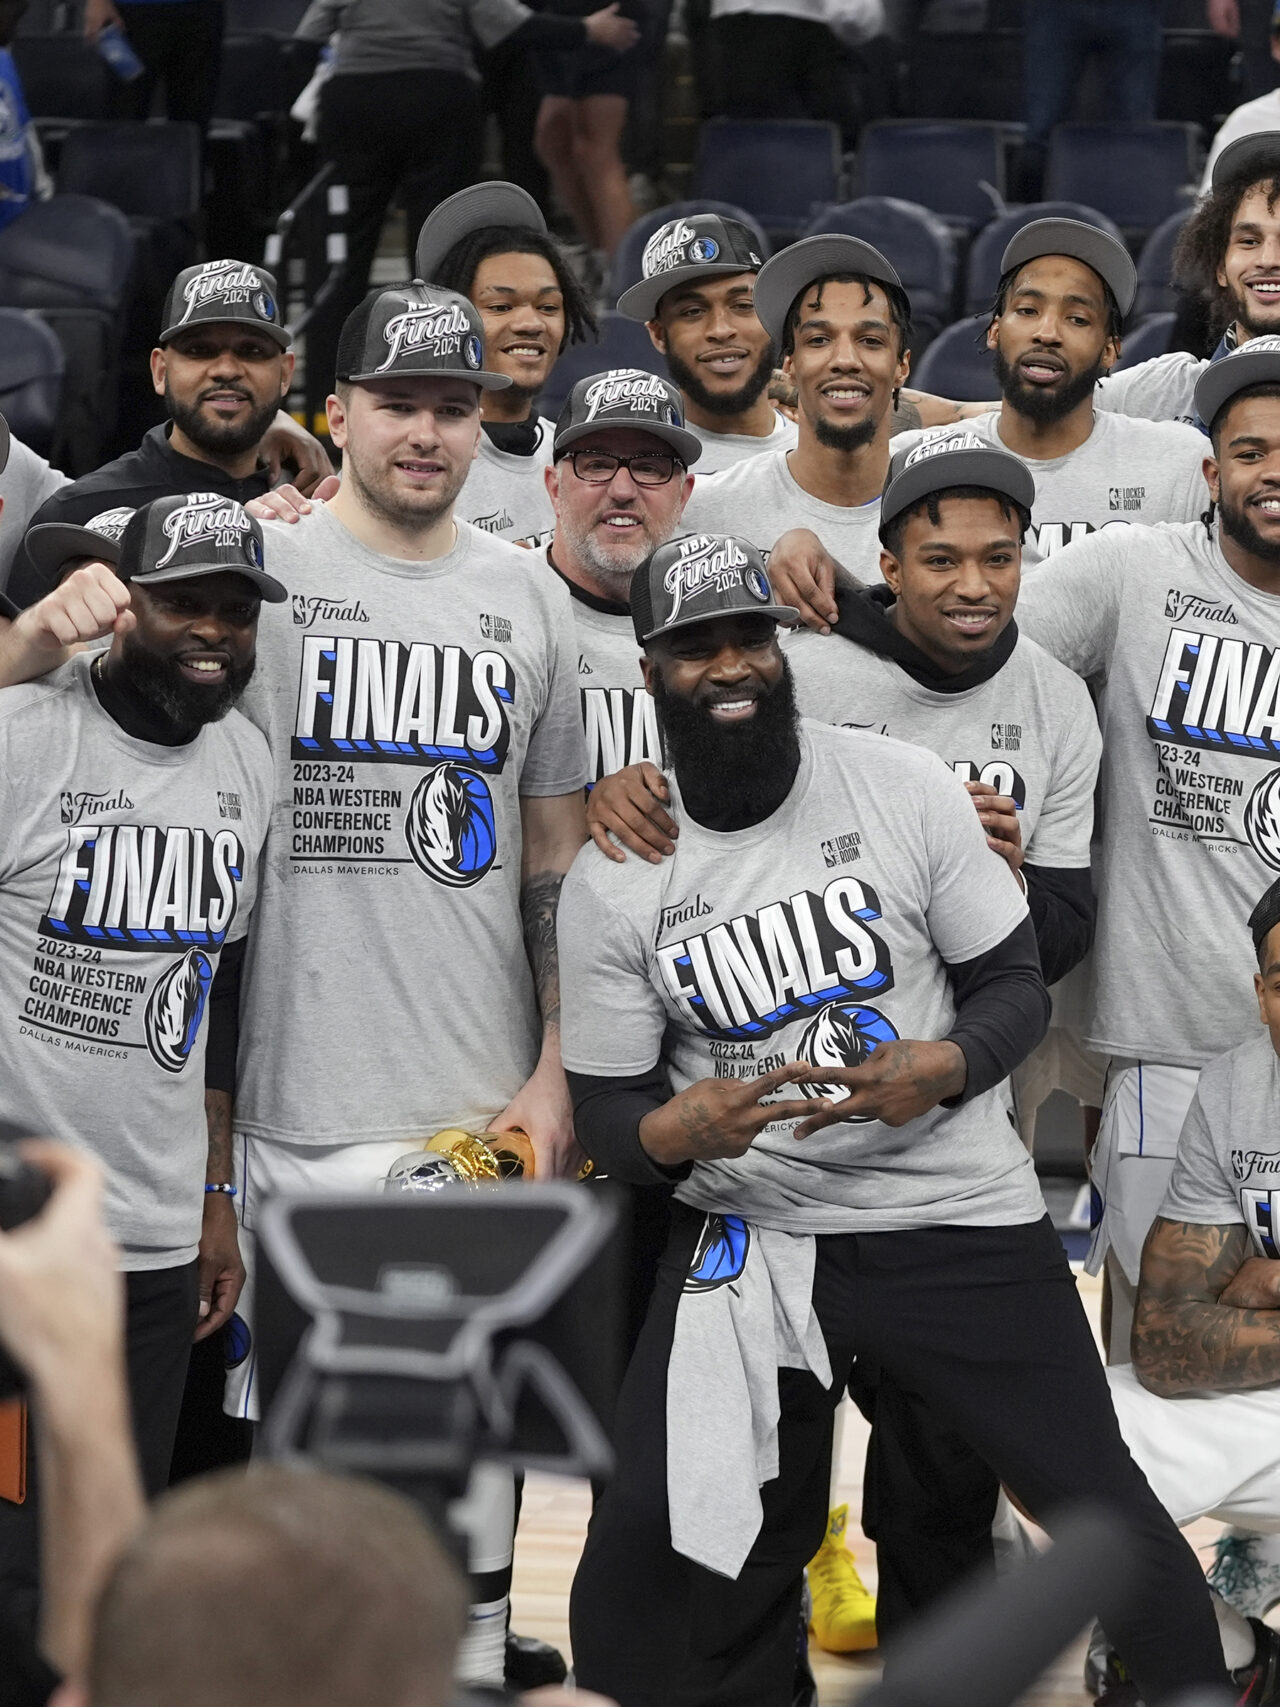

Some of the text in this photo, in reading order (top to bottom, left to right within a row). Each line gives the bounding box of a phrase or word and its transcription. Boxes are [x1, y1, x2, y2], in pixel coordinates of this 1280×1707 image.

[184, 265, 262, 326] Finals
[223, 290, 250, 305] 2024
[383, 304, 471, 374] Finals
[433, 336, 460, 357] 2024
[584, 375, 669, 423] Finals
[630, 398, 658, 413] 2024
[1122, 486, 1147, 499] LOCKER
[1122, 499, 1142, 512] ROOM
[154, 500, 252, 569] Finals
[215, 530, 243, 547] 2024
[678, 535, 711, 558] NBA
[663, 537, 750, 628] Finals
[713, 569, 744, 594] 2024
[301, 596, 371, 629] Finals
[1171, 593, 1240, 626] Finals
[294, 635, 514, 757] FINALS
[293, 763, 355, 783] 2023-24
[1175, 768, 1245, 797] WESTERN
[68, 788, 135, 827] Finals
[292, 787, 402, 808] NBA WESTERN
[292, 811, 392, 831] CONFERENCE
[292, 834, 385, 854] CHAMPIONS
[834, 831, 862, 851] LOCKER
[1151, 827, 1190, 842] DALLAS
[838, 846, 862, 865] ROOM
[46, 824, 244, 938] FINALS
[293, 865, 400, 876] DALLAS MAVERICKS
[36, 937, 103, 964] 2023-24
[655, 876, 884, 1031] FINALS
[33, 956, 148, 994] NBA WESTERN
[28, 975, 134, 1016] CONFERENCE
[23, 997, 121, 1038] CHAMPIONS
[19, 1025, 129, 1060] DALLAS MAVERICKS
[708, 1041, 756, 1061] 2023-24
[713, 1060, 736, 1080] NBA
